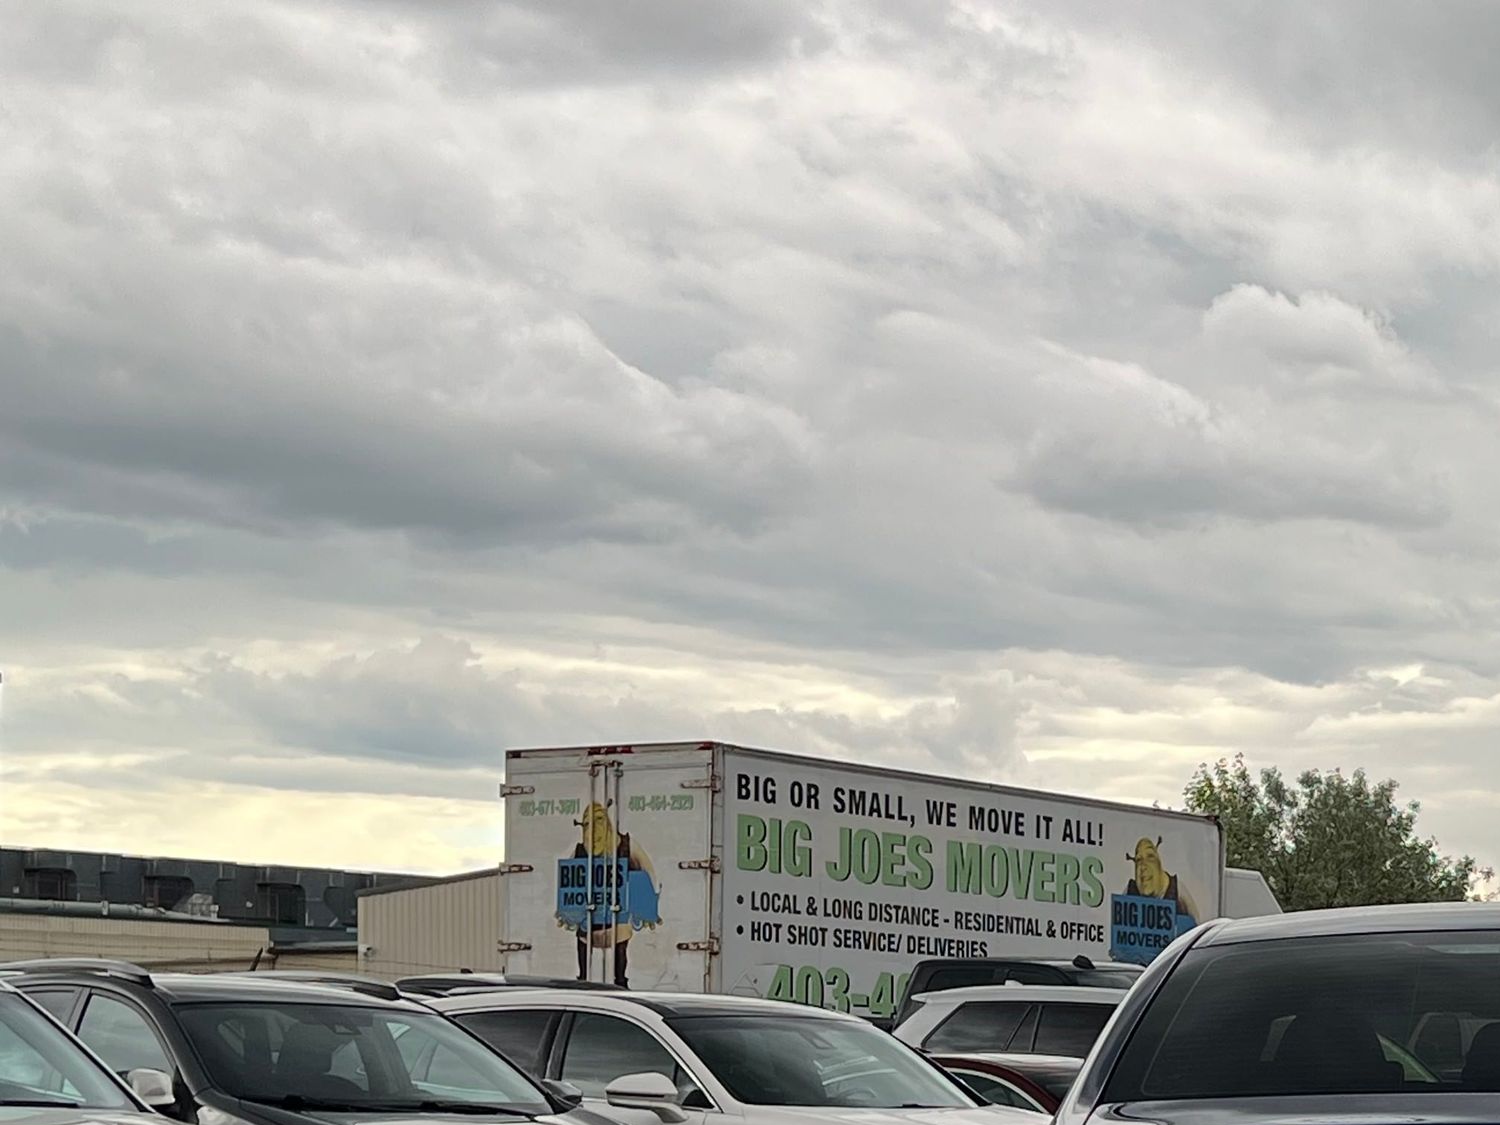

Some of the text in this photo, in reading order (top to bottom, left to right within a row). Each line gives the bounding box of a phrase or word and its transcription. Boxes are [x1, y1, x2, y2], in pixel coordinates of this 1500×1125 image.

[737, 774, 1103, 846] BIG OR SMALL, WE MOVE IT ALL!
[560, 864, 586, 888] BIG
[737, 814, 1104, 908] BIG JOES MOVERS
[751, 891, 801, 915] LOCAL
[806, 896, 818, 916] &
[823, 898, 863, 920] LONG
[868, 902, 939, 928] DISTANCE
[954, 911, 1042, 937] RESIDENTIAL
[1046, 919, 1056, 938] &
[1060, 921, 1104, 942] OFFICE
[1114, 901, 1172, 930] BIG JOES
[751, 921, 988, 958] HOT SHOT SERVICE/ DELIVERIES
[1117, 931, 1169, 948] MOVERS
